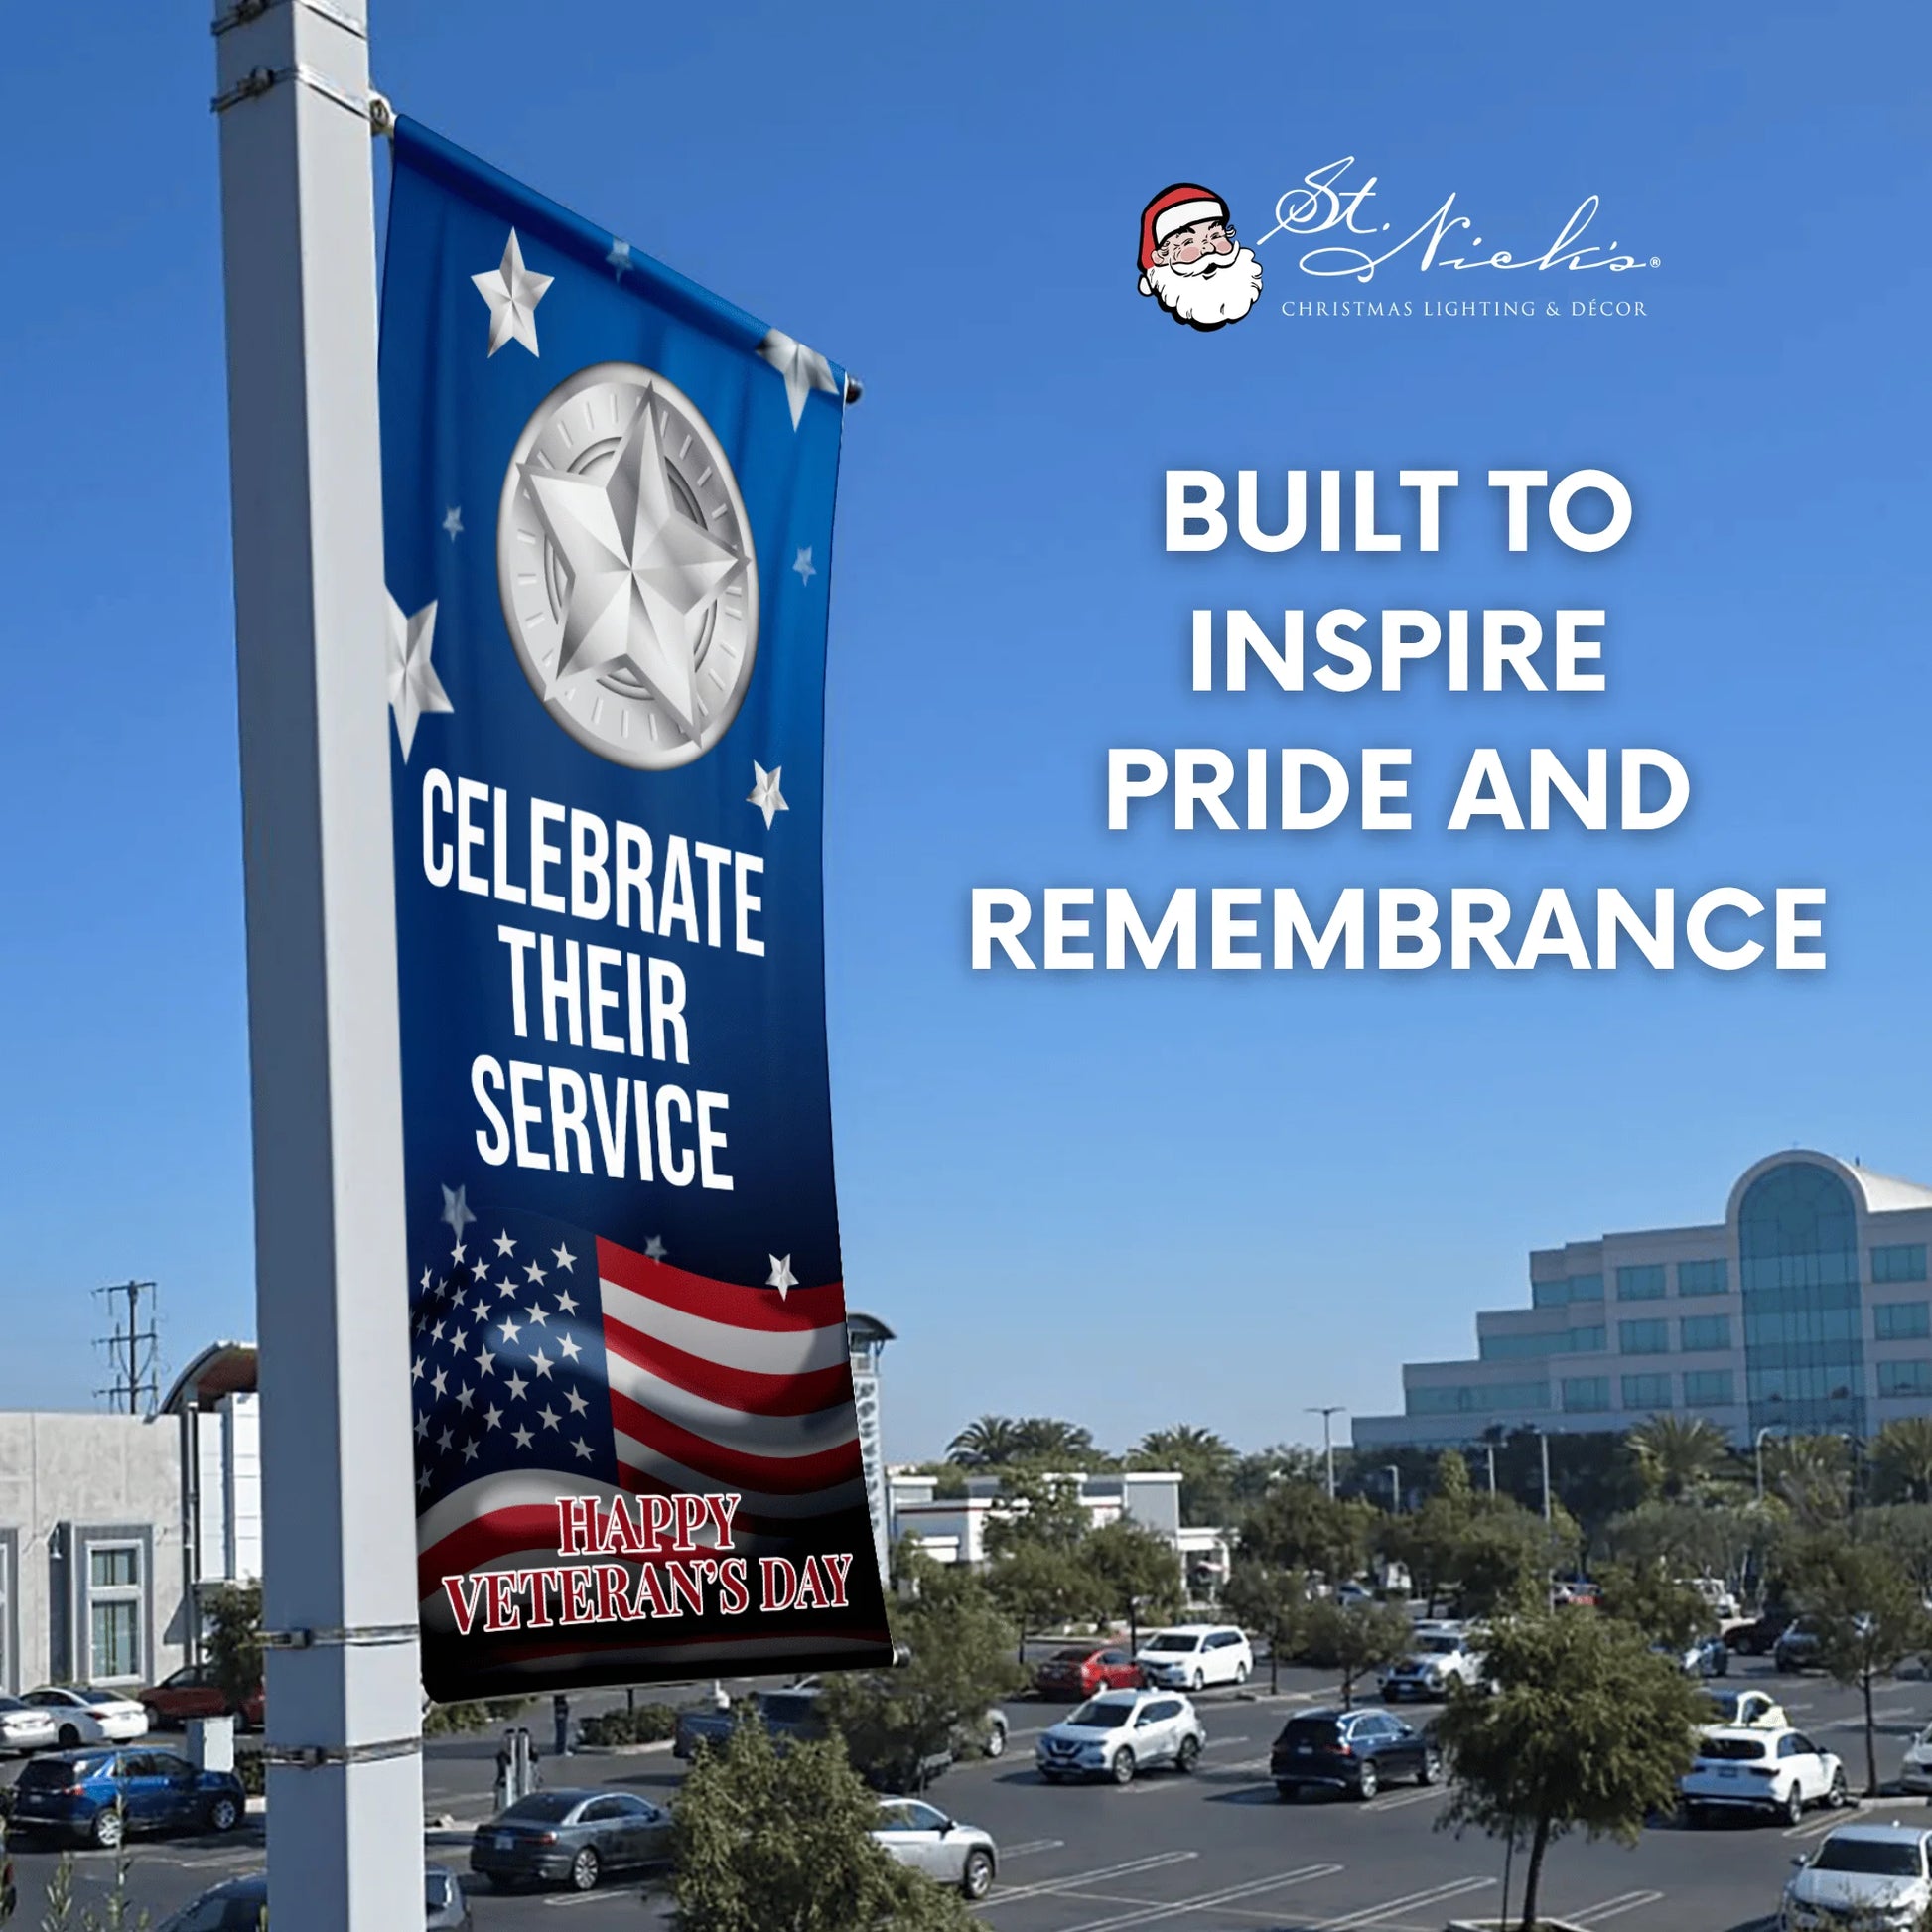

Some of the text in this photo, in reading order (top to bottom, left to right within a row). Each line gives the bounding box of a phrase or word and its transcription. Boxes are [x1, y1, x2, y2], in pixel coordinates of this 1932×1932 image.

[422, 767, 765, 957] CELEBRATE
[497, 924, 690, 1065] THEIR
[471, 1054, 734, 1191] SERVICE
[555, 1493, 741, 1557] HAPPY
[441, 1553, 854, 1635] VETERAN'S DAY
